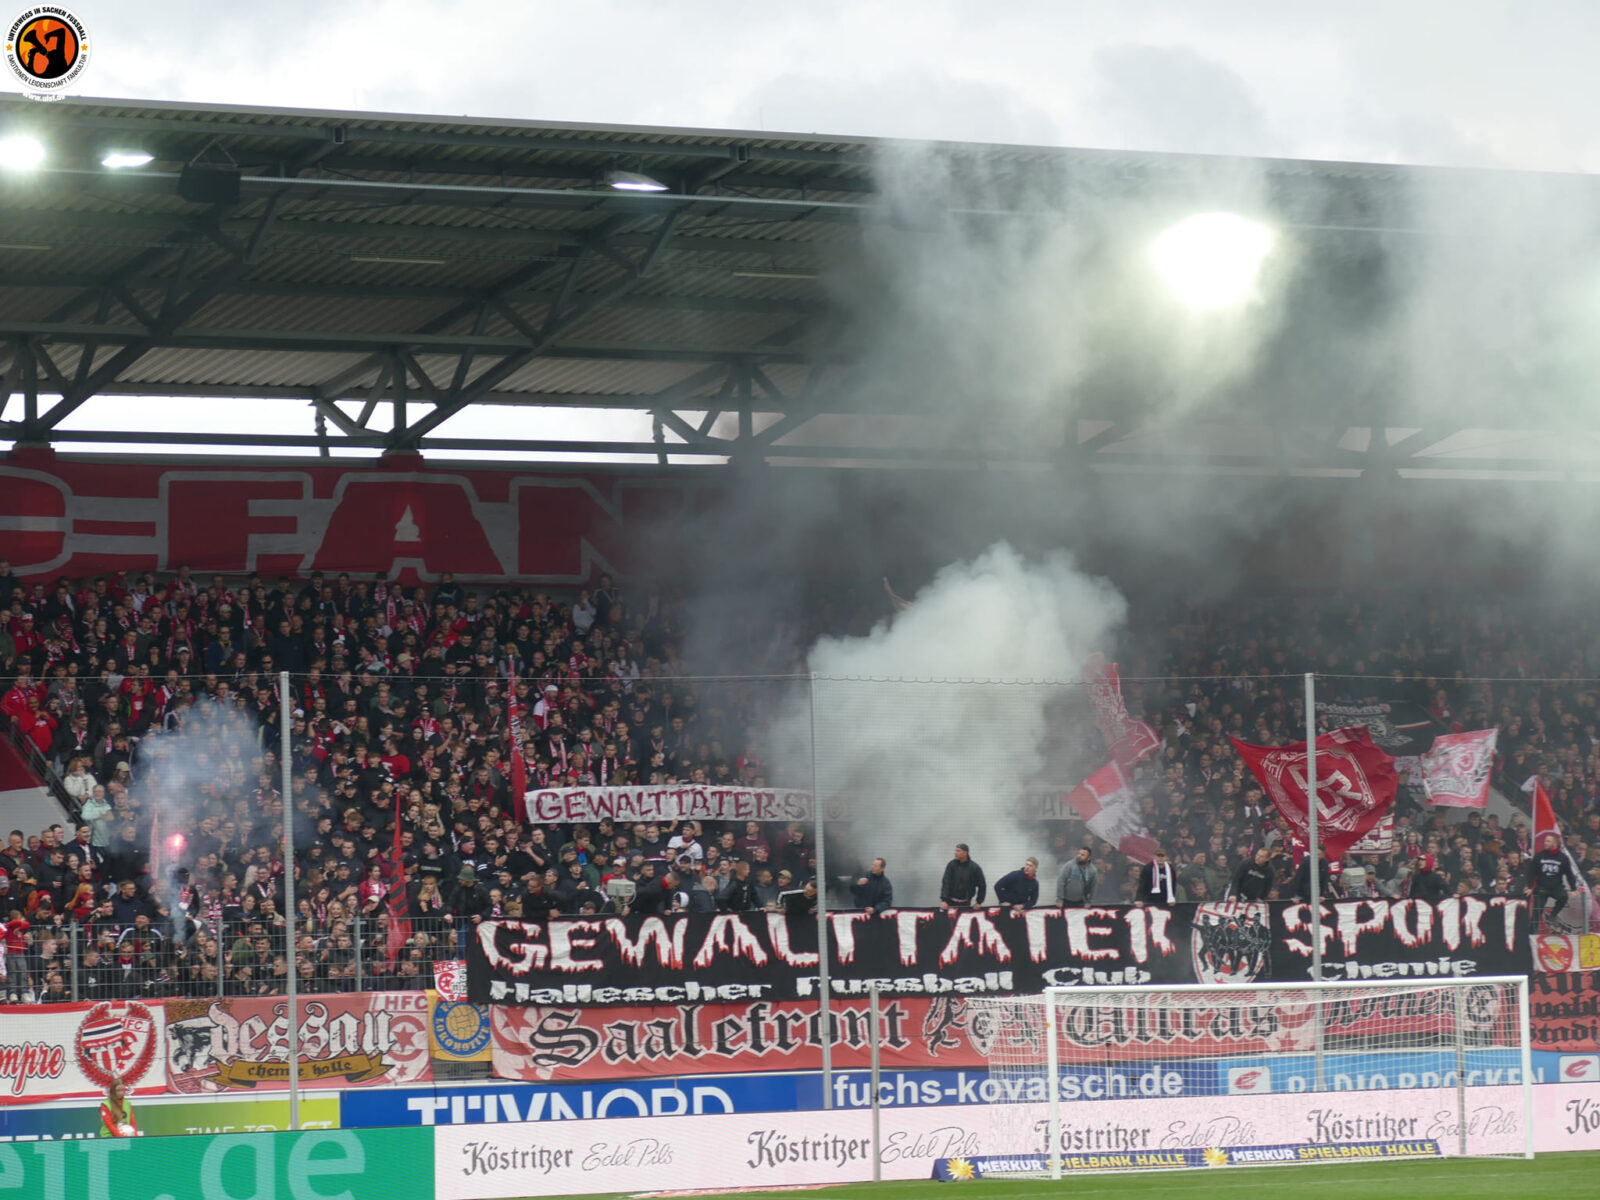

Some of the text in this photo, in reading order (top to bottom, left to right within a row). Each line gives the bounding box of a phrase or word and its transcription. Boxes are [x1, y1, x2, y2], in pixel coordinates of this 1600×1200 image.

[1283, 896, 1528, 957] SPORT
[490, 979, 772, 1004] Hallescher
[796, 970, 1013, 996] Fussball
[1042, 966, 1151, 985] Club
[1307, 957, 1477, 981] Chemie
[384, 995, 428, 1011] HFC
[121, 1017, 144, 1030] HFC
[529, 1001, 910, 1068] Saalefront
[834, 1066, 1183, 1107] fuchs-kovatsch.de
[1160, 1121, 1213, 1150] Edel
[1205, 1116, 1257, 1148] Pils
[1306, 1109, 1419, 1145] Köstritzer
[1473, 1106, 1518, 1138] Pils
[463, 1138, 674, 1176] Köstritzer Edel Pils
[747, 1126, 981, 1169] Köstritzer Edel Pils
[977, 1153, 1185, 1174] MERKUR SPIELBANK HALLE
[1232, 1143, 1436, 1163] MERKUR SPIELBANK HALLE
